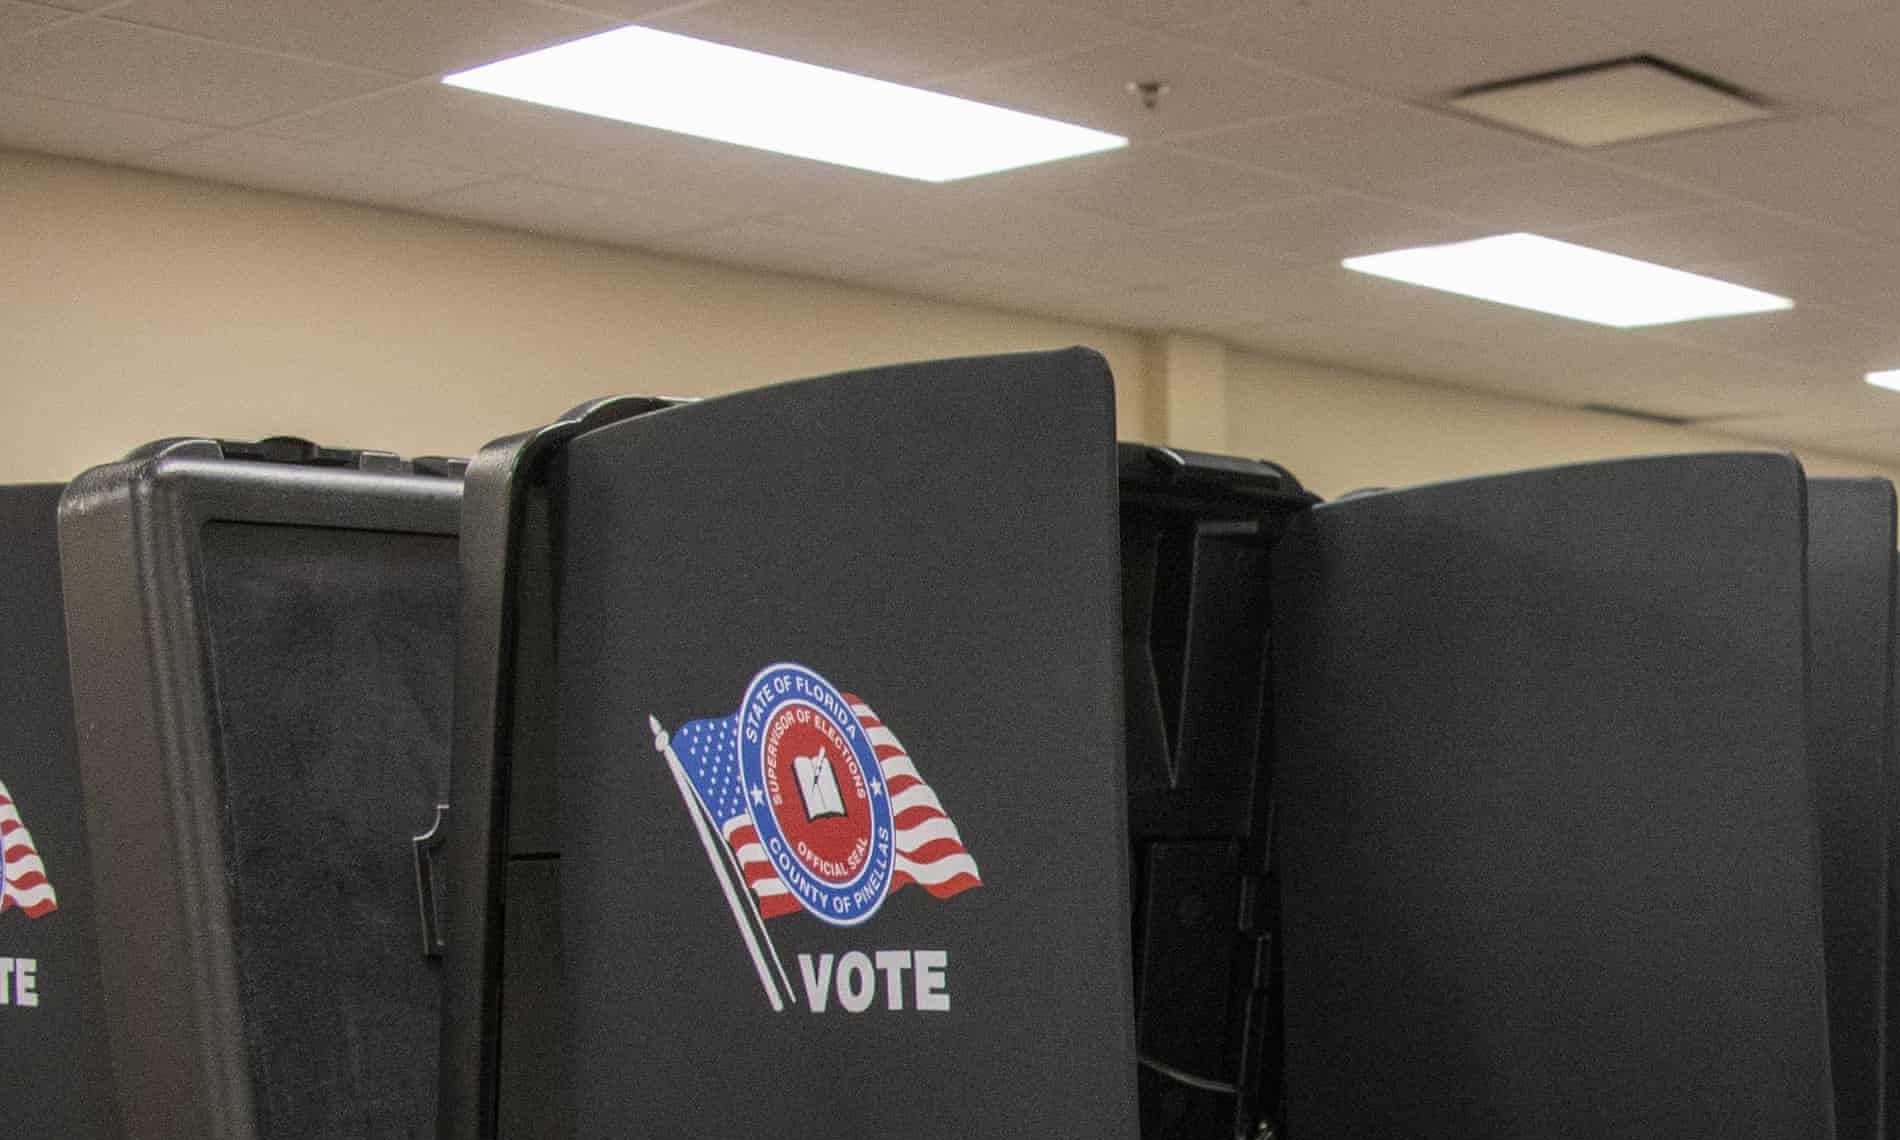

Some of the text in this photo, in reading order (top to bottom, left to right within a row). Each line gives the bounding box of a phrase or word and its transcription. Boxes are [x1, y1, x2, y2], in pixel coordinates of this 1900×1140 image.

[746, 675, 856, 743] STATE OF FLORIDA
[767, 708, 866, 805] SUPERVISOR OF ELECTIONS
[769, 826, 889, 913] COUNTY OF PINELLAS
[798, 837, 868, 877] OFFICIAL SEAL
[797, 951, 950, 1013] VOTE
